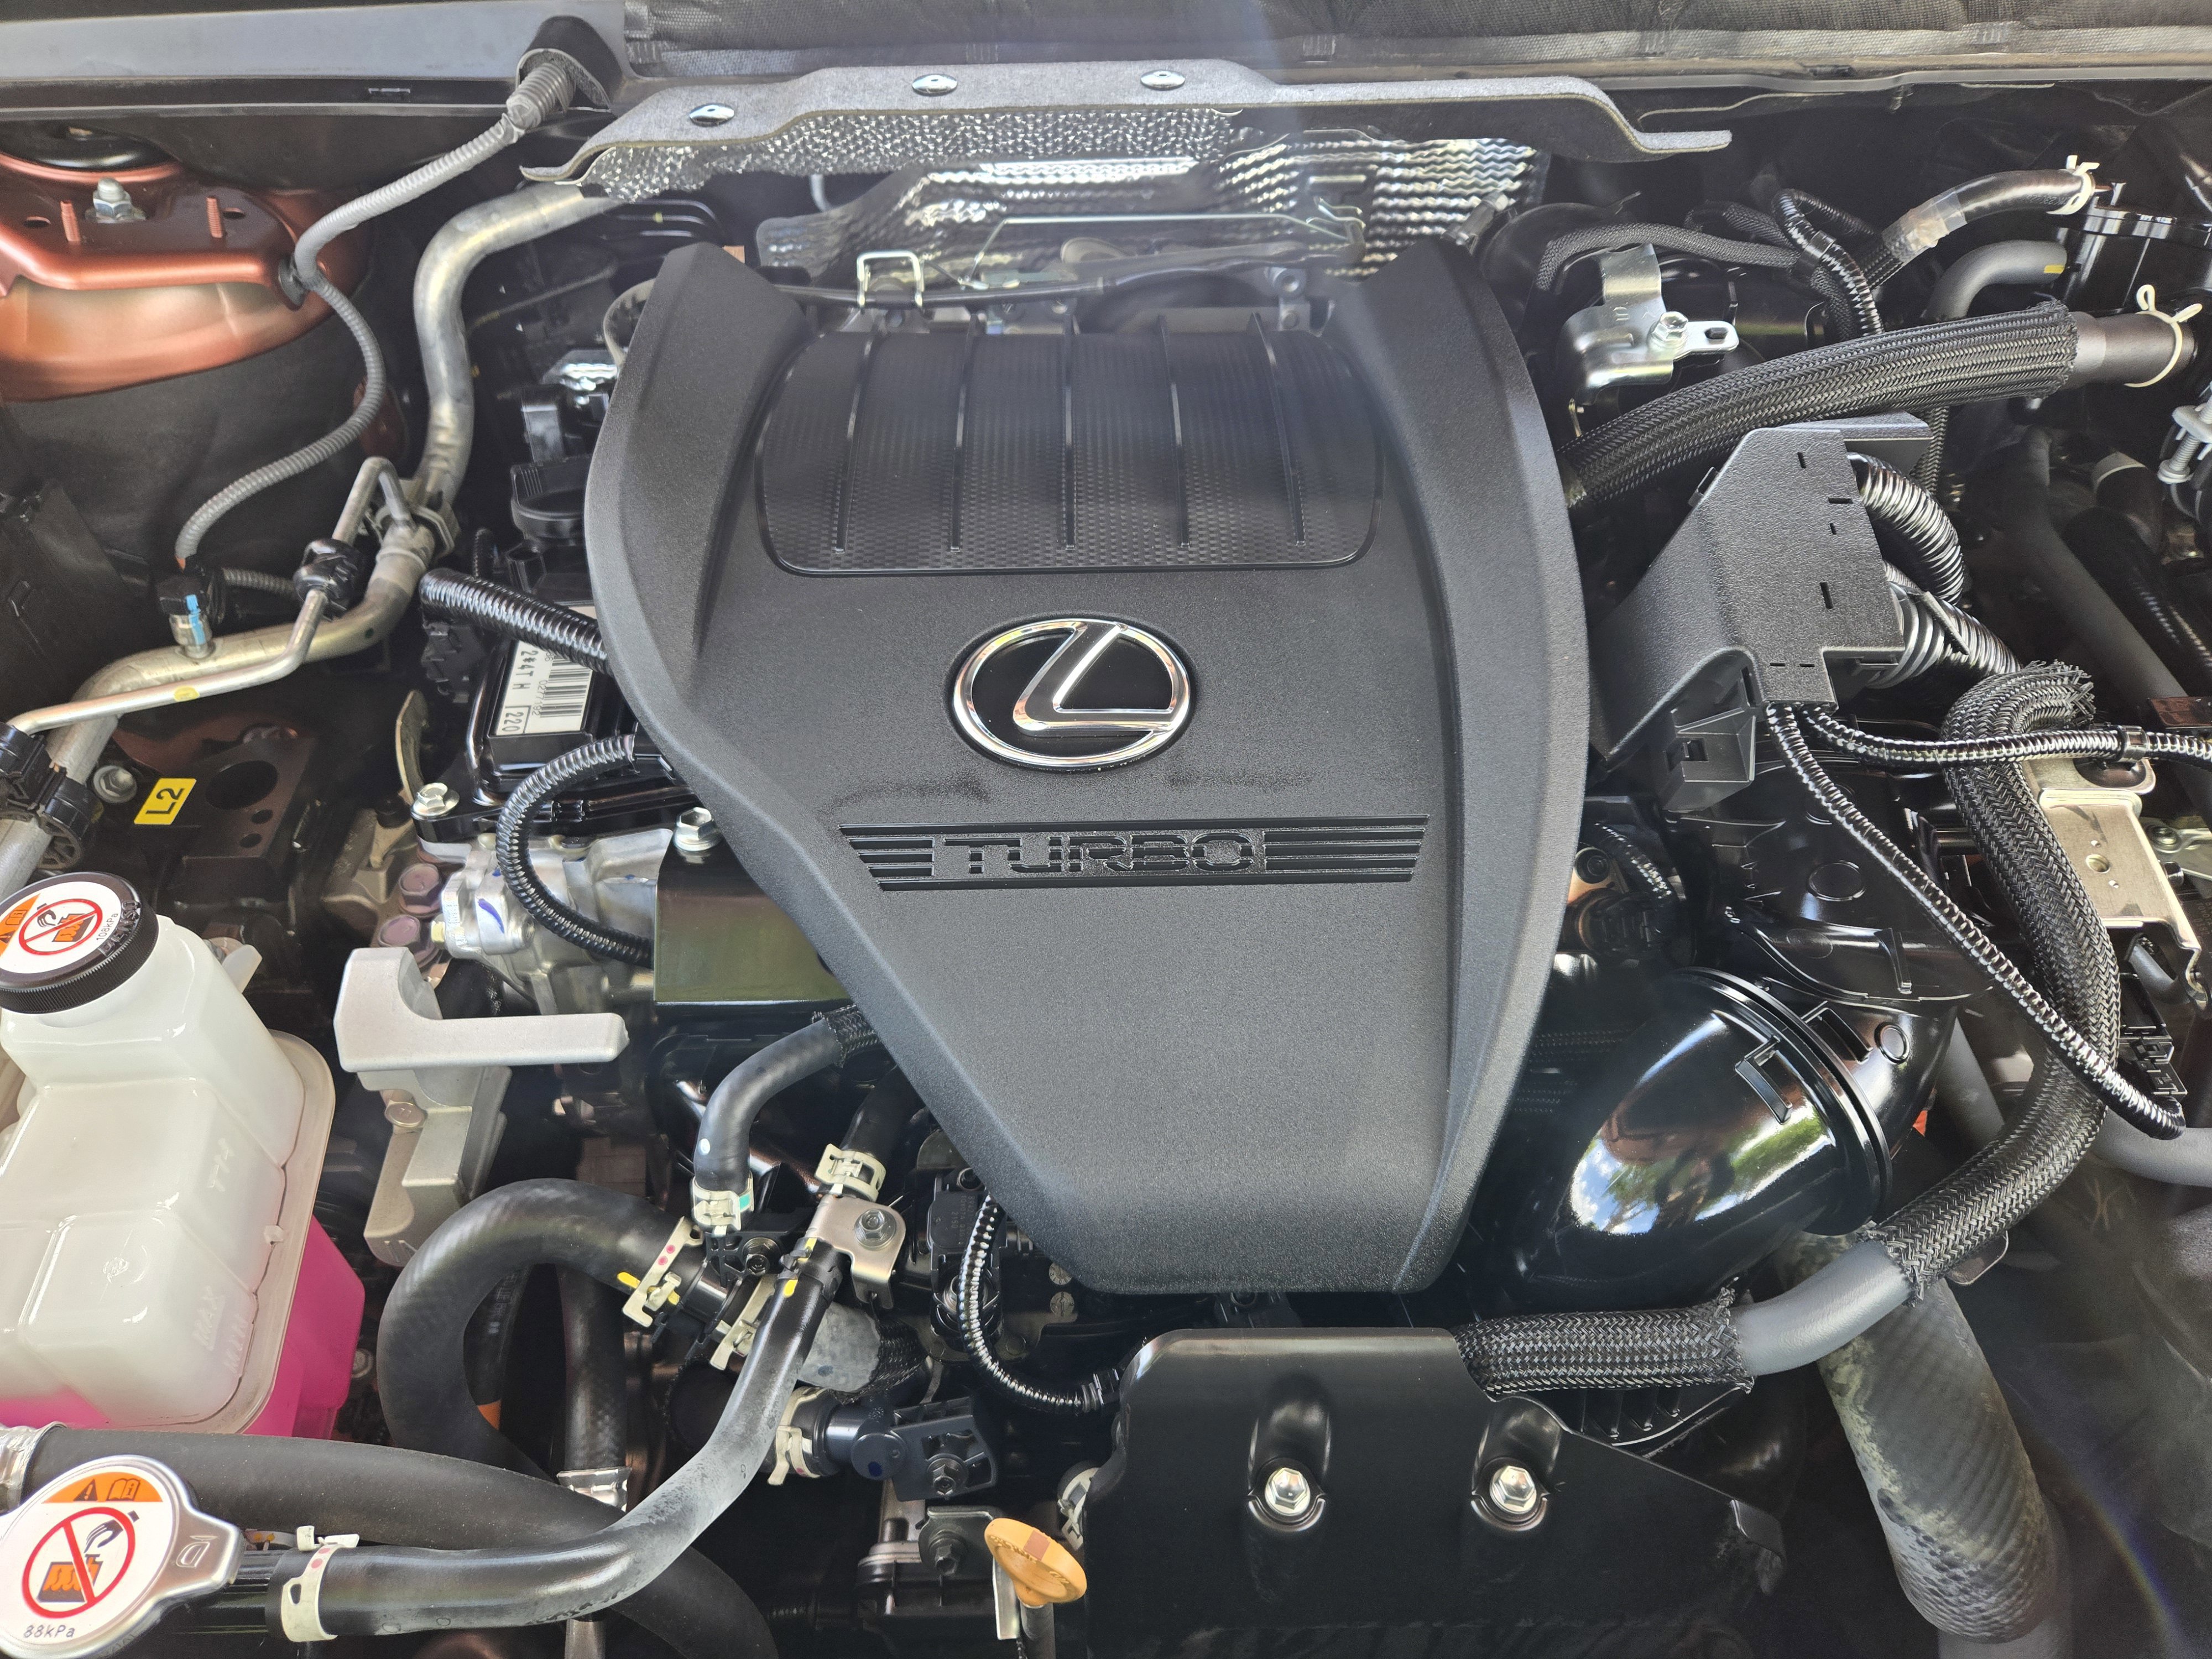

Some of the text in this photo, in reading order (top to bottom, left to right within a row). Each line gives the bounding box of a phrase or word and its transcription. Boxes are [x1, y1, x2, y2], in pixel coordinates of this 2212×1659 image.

[502, 712, 524, 732] 220
[145, 788, 185, 814] L2
[943, 832, 1254, 873] TURBO
[96, 913, 118, 940] 108kPa
[97, 900, 140, 957] DENSO
[194, 1286, 217, 1346] MAX
[23, 1624, 75, 1638] 88kPa
